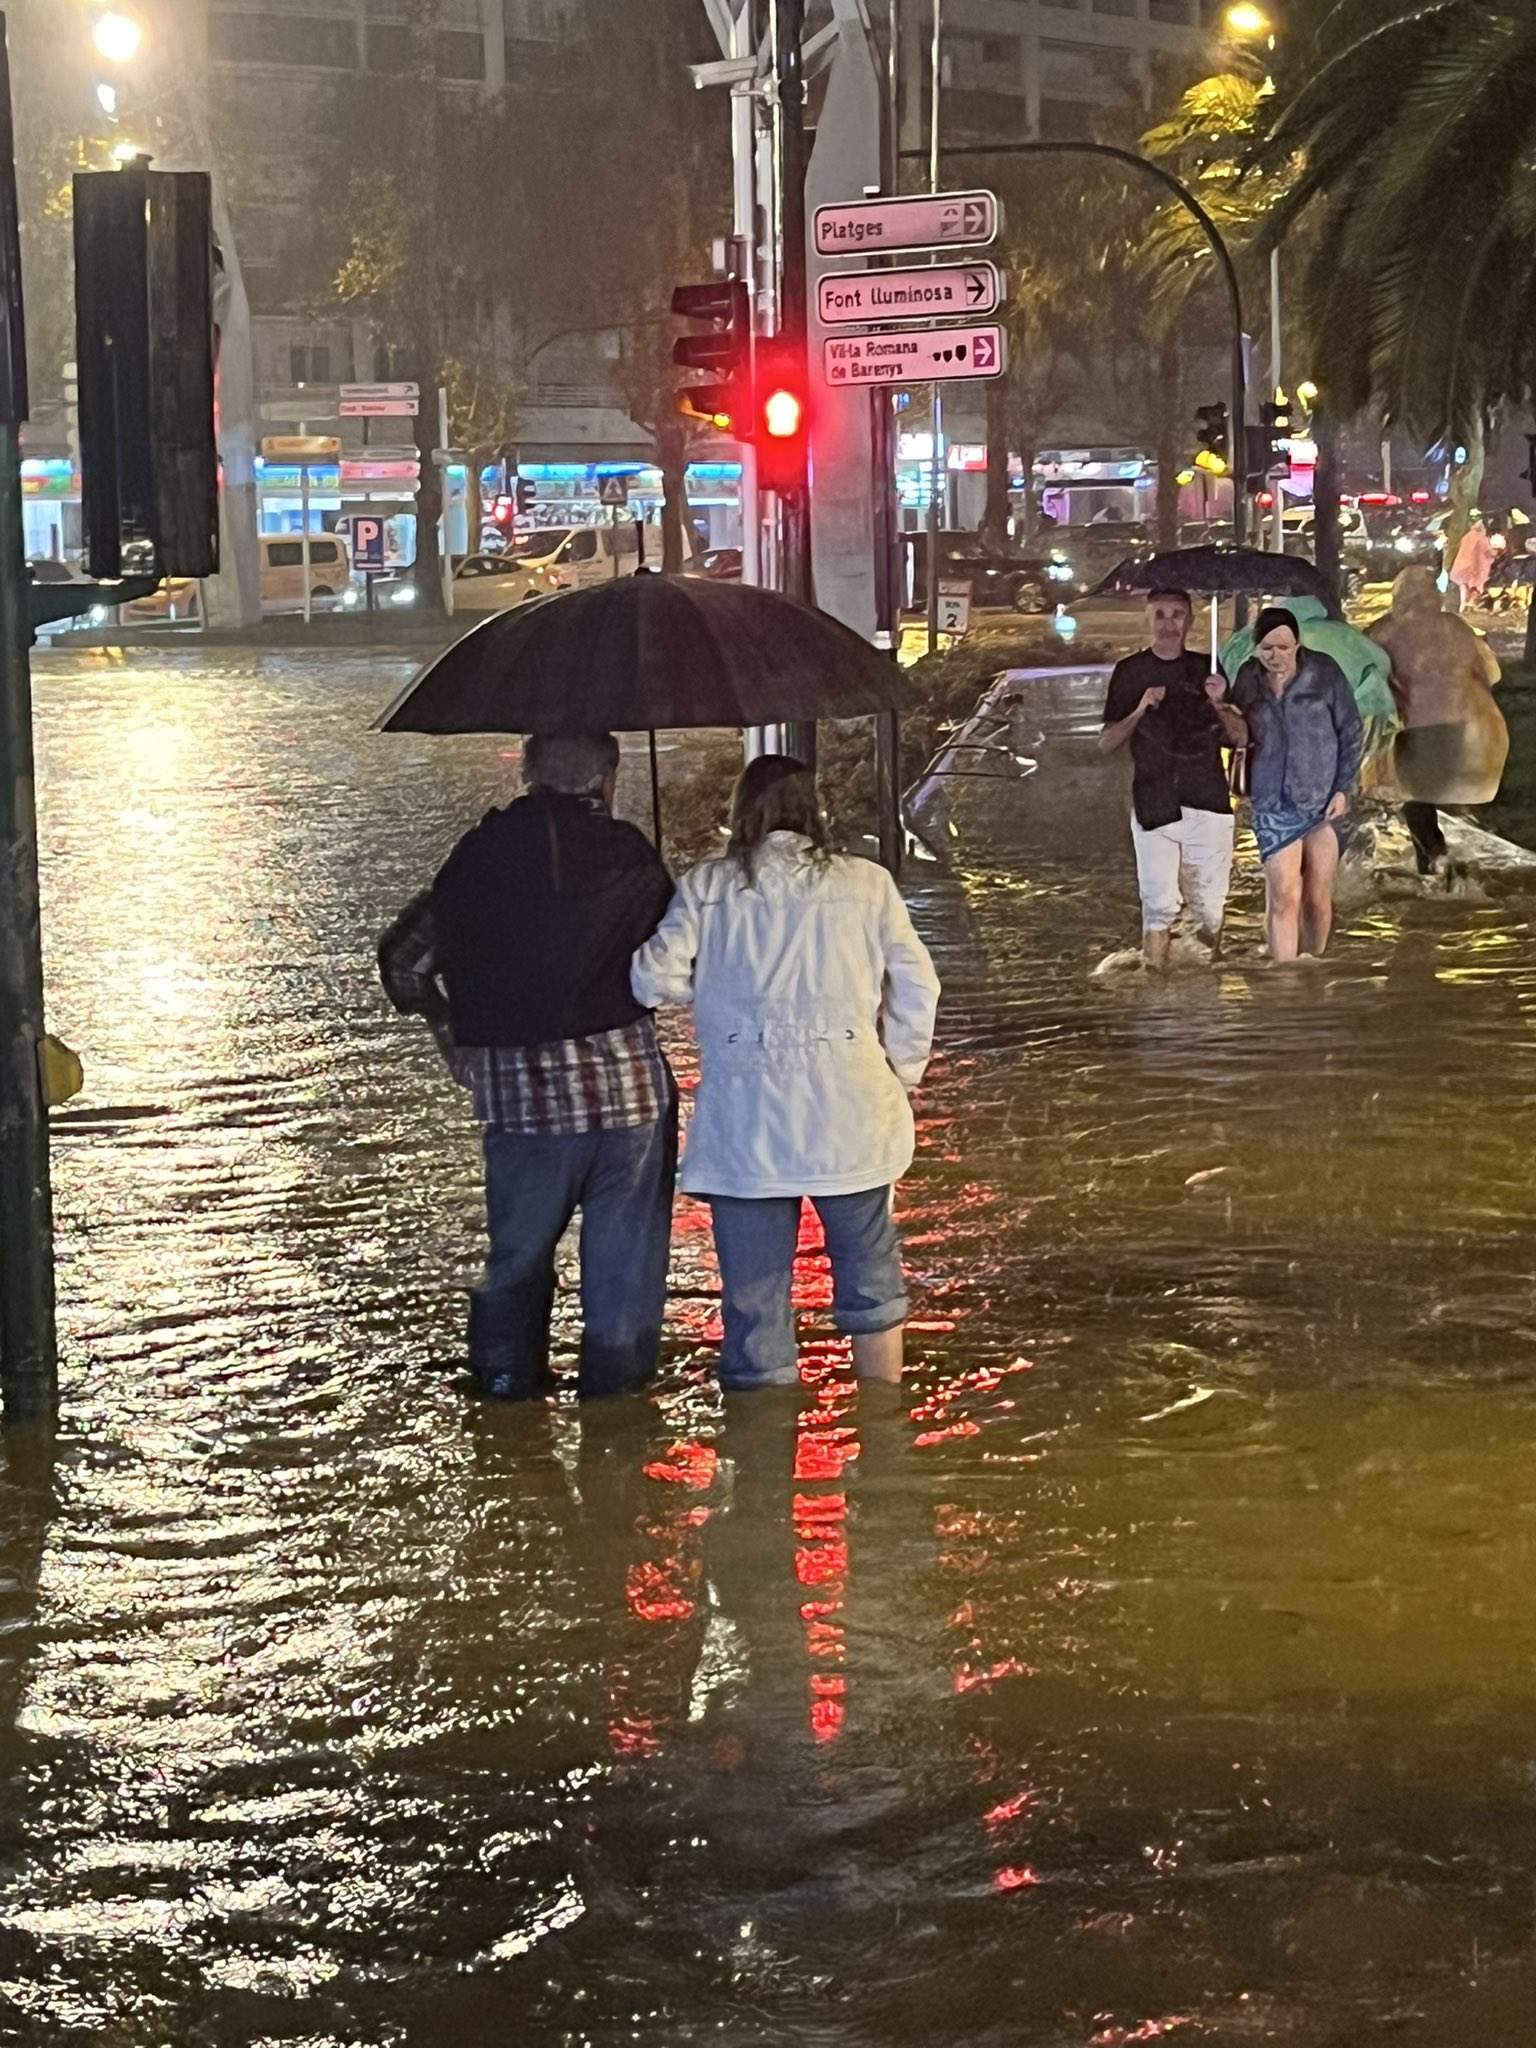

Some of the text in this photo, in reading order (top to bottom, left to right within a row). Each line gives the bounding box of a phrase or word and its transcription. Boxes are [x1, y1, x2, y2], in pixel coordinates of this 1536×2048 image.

[822, 221, 883, 241] Platges
[825, 290, 862, 309] Font
[866, 341, 918, 357] Romana
[832, 363, 903, 379] de Barenys
[357, 520, 379, 550] P
[946, 613, 957, 628] 2
